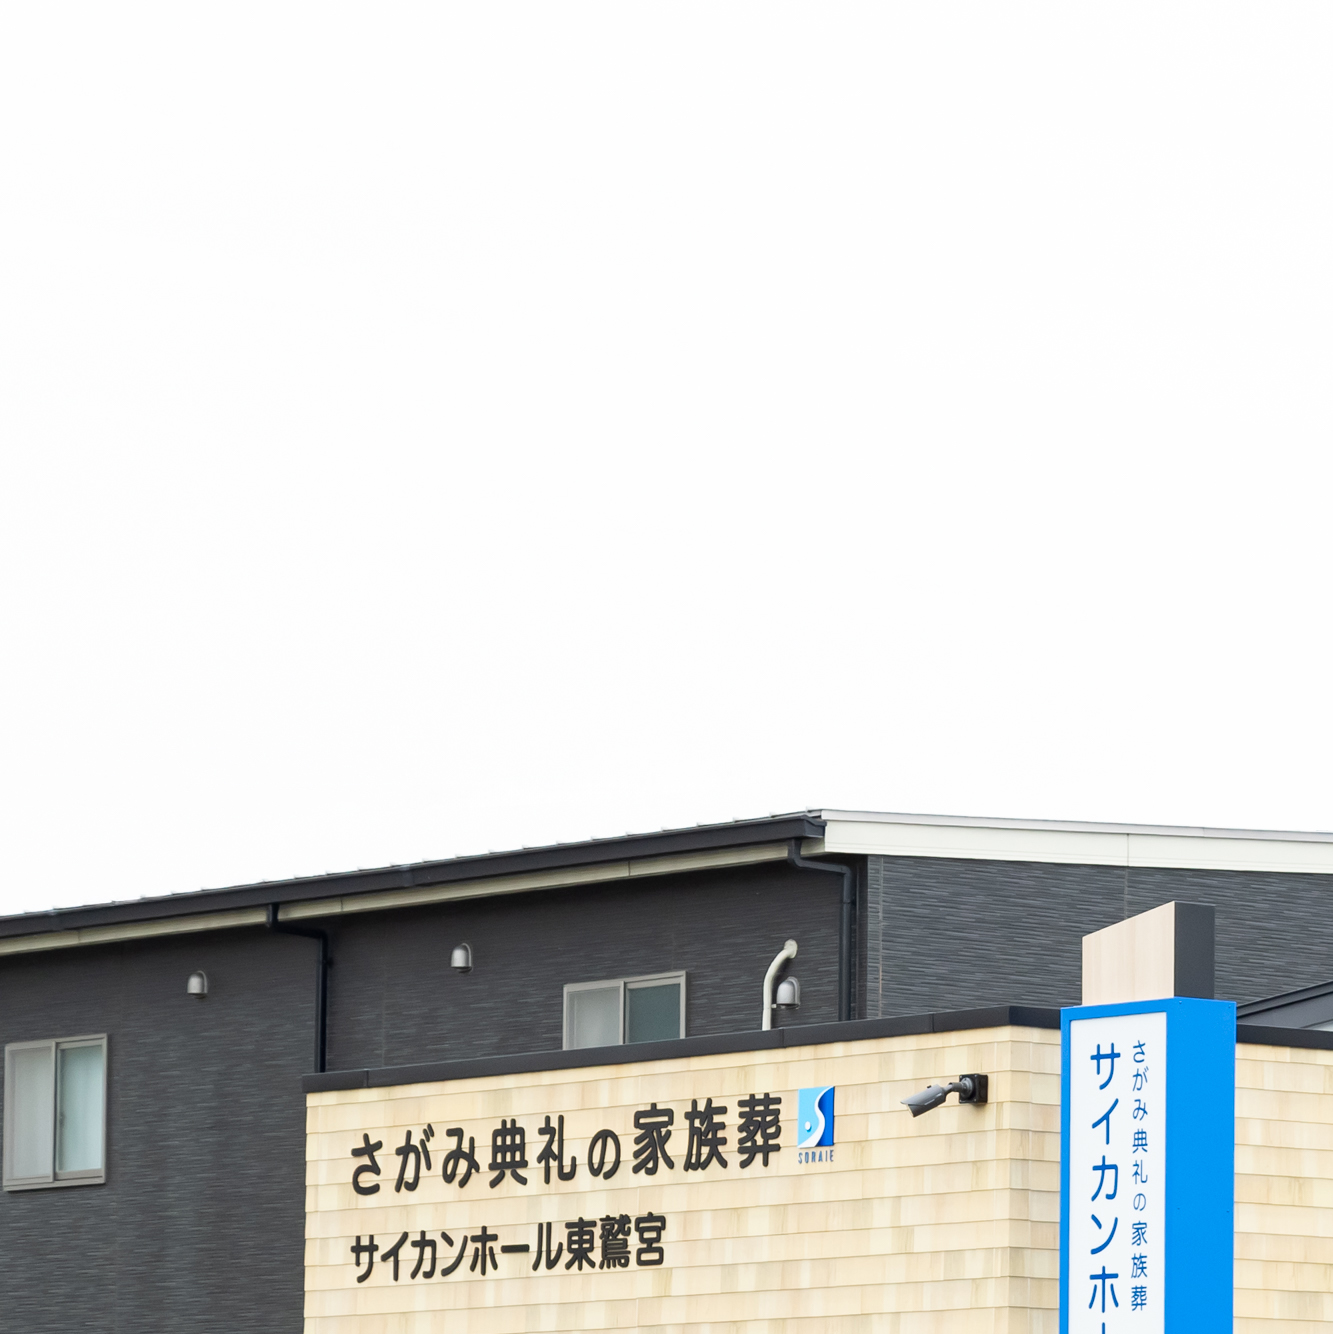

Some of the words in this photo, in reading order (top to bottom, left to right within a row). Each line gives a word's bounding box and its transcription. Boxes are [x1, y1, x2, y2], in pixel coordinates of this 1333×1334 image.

[351, 1093, 782, 1196] さがみ典礼の家族葬
[798, 1149, 834, 1164] SORAIE
[1131, 1040, 1149, 1311] さがみ典礼の家族葬
[351, 1211, 667, 1284] サイカンホール東鷲宮
